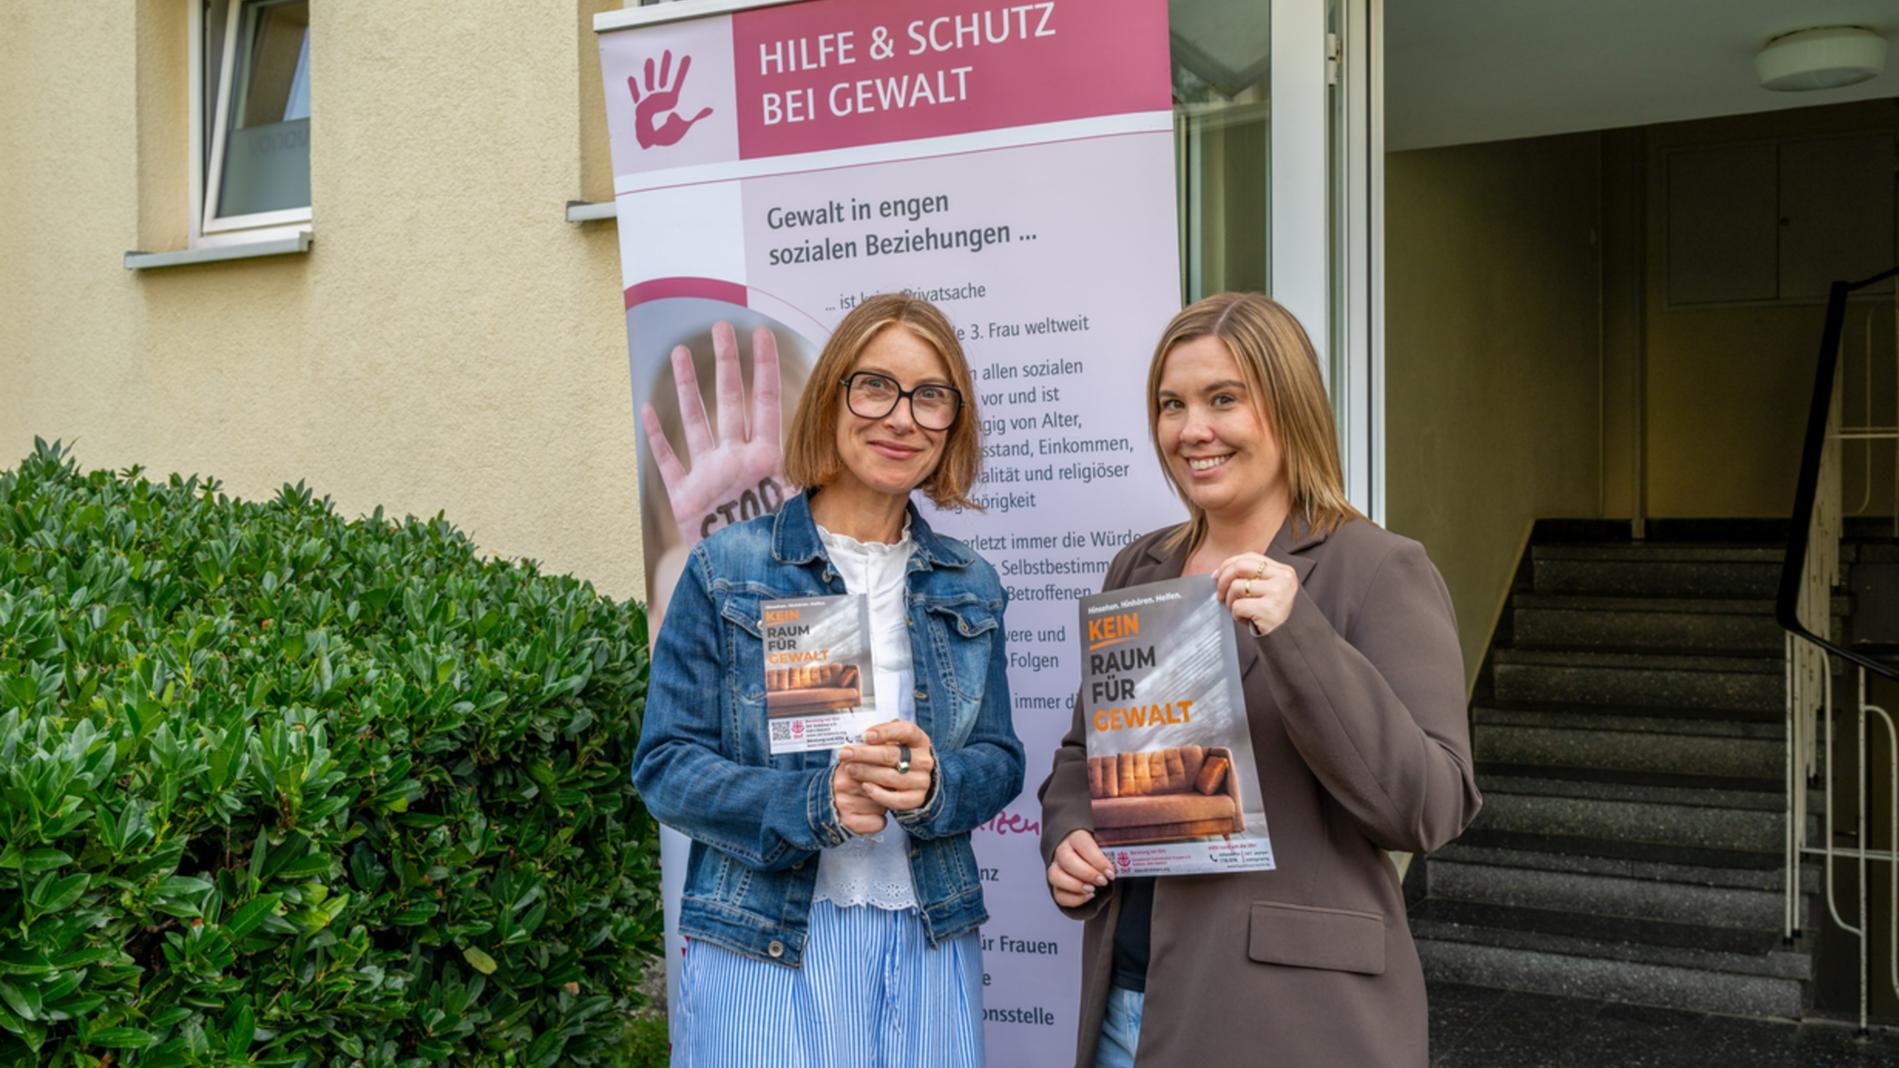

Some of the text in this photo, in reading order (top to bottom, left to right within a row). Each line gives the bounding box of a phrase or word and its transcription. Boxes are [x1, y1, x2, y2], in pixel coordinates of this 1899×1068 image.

[760, 2, 1056, 75] HILFE & SCHUTZ
[762, 66, 973, 125] BEI GEWALT
[767, 194, 949, 230] Gewalt in engen
[769, 238, 857, 265] sozialen
[865, 225, 1010, 256] Beziehungen
[840, 294, 856, 310] ist
[970, 324, 984, 340] 3.
[988, 322, 1019, 339] Frau
[1025, 315, 1090, 335] weltweit
[982, 363, 1018, 380] allen
[1022, 358, 1083, 378] sozialen
[981, 386, 1060, 406] vor und ist
[1010, 417, 1037, 430] von
[1041, 411, 1082, 429] Alter,
[1039, 437, 1134, 455] Einkommen,
[1025, 464, 1053, 481] und
[1059, 462, 1130, 483] religiöser
[1011, 533, 1057, 549] immer
[1062, 531, 1086, 548] die
[1006, 583, 1092, 601] Betroffenen
[765, 608, 800, 622] KEIN
[767, 625, 810, 638] RAUM
[1038, 625, 1066, 642] und
[1088, 612, 1139, 641] KEIN
[768, 638, 797, 651] FÜR
[768, 648, 829, 664] GEWALT
[1010, 651, 1059, 672] Folgen
[1090, 645, 1156, 675] RAUM
[1092, 674, 1136, 704] FÜR
[1014, 692, 1061, 709] immer
[1094, 700, 1193, 732] GEWALT
[1000, 935, 1058, 955] Frauen
